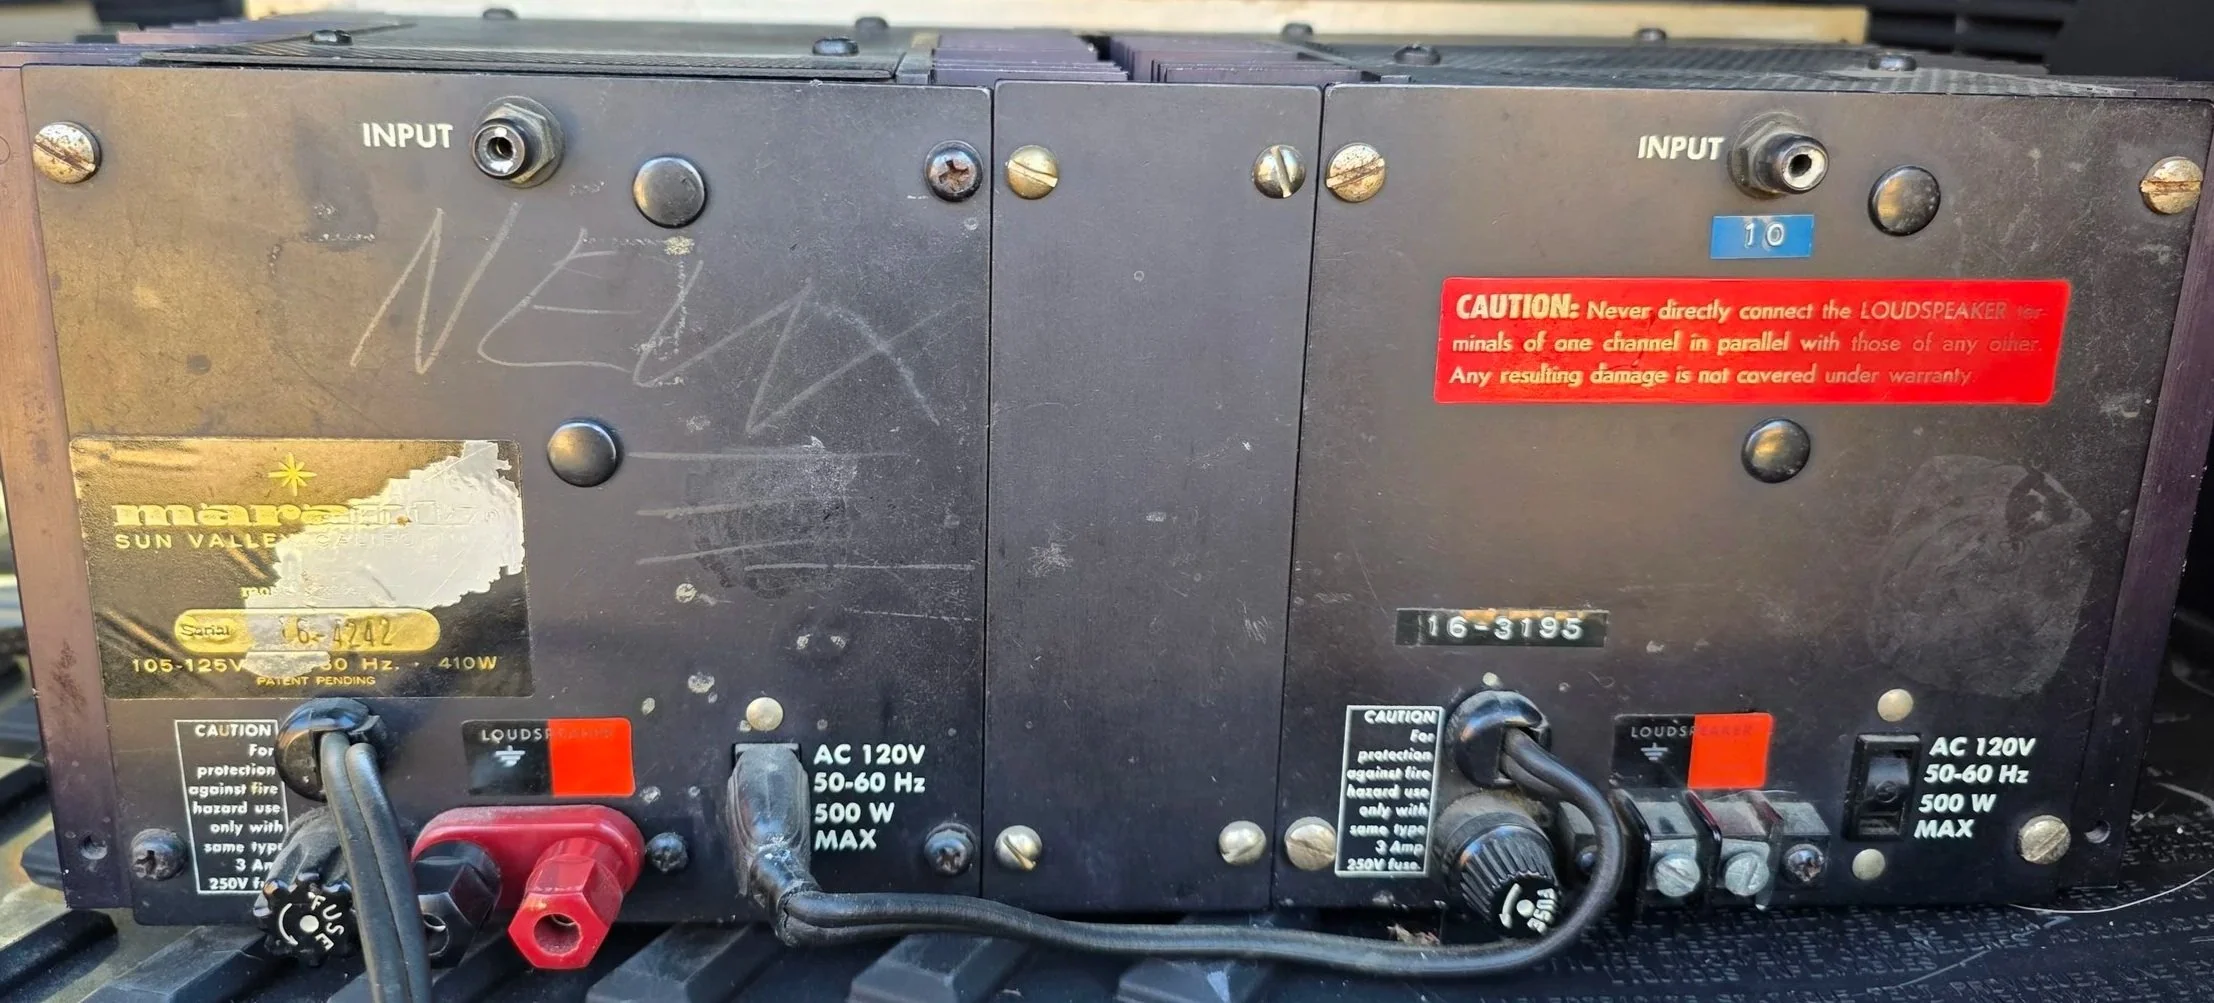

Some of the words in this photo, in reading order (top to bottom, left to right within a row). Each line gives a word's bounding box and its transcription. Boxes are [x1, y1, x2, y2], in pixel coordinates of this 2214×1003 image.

[362, 122, 454, 149] INPUT
[1637, 135, 1724, 161] INPUT
[1743, 221, 1786, 250] 10
[1455, 293, 1580, 320] CAUTION:
[1587, 300, 1651, 320] Never
[1657, 297, 1731, 323] directly
[1739, 302, 1813, 320] connect
[1822, 299, 1851, 319] the
[1860, 301, 2007, 321] LOUDSPEAKER
[1452, 330, 1513, 353] minals
[1523, 330, 1548, 352] of
[1554, 335, 1593, 351] one
[1603, 328, 1680, 351] channel
[1690, 332, 1710, 351] in
[1717, 330, 1790, 356] parallel
[1800, 330, 1841, 351] with
[1851, 331, 1902, 352] those
[1912, 331, 1935, 352] of
[1942, 336, 1978, 358] any
[1449, 365, 1490, 388] Any
[1500, 362, 1583, 387] resulting
[1590, 363, 1670, 389] damage
[1675, 365, 1691, 384] is
[1699, 367, 1728, 384] not
[1736, 363, 1818, 385] covered
[1824, 363, 1880, 385] under
[115, 533, 173, 549] SUN
[180, 624, 230, 637] Serial
[1426, 615, 1583, 641] 16-3195
[131, 657, 244, 673] 105-125V
[438, 656, 499, 671] 410W
[256, 675, 309, 687] PATENT
[316, 675, 377, 687] PENDING
[1364, 709, 1438, 724] CAUTION
[194, 723, 272, 738] CAUTION
[1410, 728, 1436, 743] For
[249, 744, 275, 758] For
[813, 745, 852, 765] AC
[862, 744, 926, 766] 120V
[1928, 737, 1968, 757] AC
[1975, 737, 2037, 757] 120V
[1357, 748, 1434, 765] protection
[196, 763, 276, 780] protection
[1346, 767, 1402, 785] against
[1405, 766, 1432, 782] fire
[1924, 765, 1993, 784] 50-60
[1999, 766, 2030, 784] Hz
[188, 782, 247, 799] against
[250, 781, 279, 795] fire
[813, 772, 886, 793] 50-60
[895, 772, 926, 793] Hz
[1346, 784, 1401, 799] hazard
[1404, 788, 1431, 799] use
[192, 802, 248, 815] hazard
[254, 804, 281, 815] use
[1358, 803, 1392, 820] only
[1395, 802, 1428, 816] with
[1919, 794, 1963, 814] 500
[1971, 794, 1998, 814] W
[814, 803, 863, 824] 500
[869, 803, 896, 823] W
[209, 821, 244, 838] only
[250, 822, 284, 835] with
[1349, 824, 1390, 837] same
[1393, 822, 1426, 840] type
[1914, 820, 1975, 839] MAX
[204, 844, 245, 854] same
[815, 829, 877, 851] MAX
[1375, 841, 1389, 854] 3
[1390, 841, 1425, 857] Amp
[236, 859, 247, 872] 3
[251, 860, 275, 872] Am
[1346, 859, 1386, 871] 250V
[208, 878, 248, 891] 250V
[308, 893, 346, 951] FUSE
